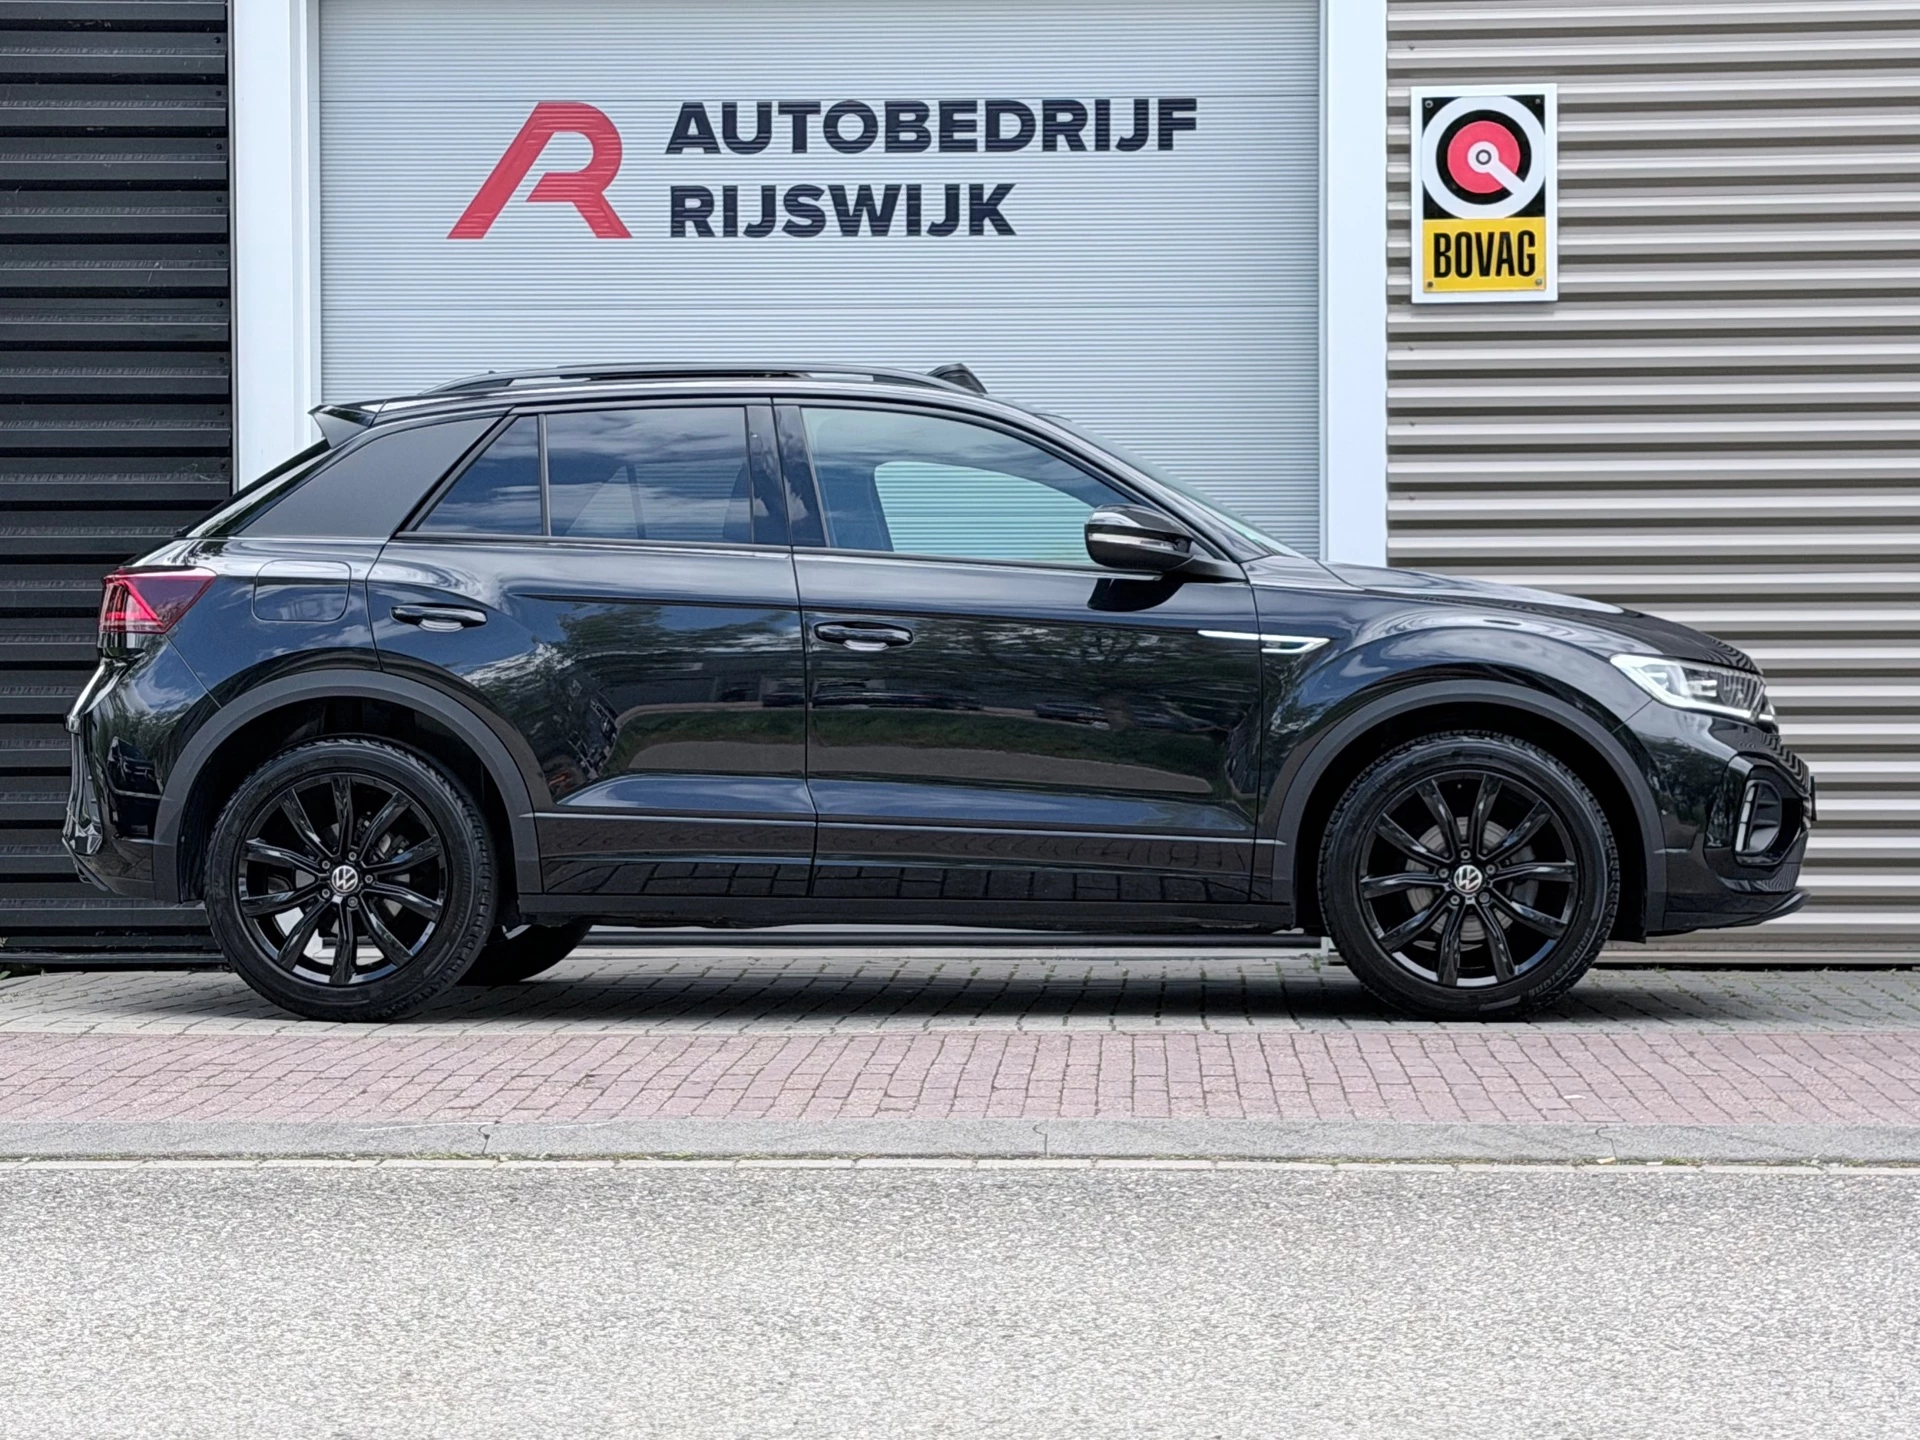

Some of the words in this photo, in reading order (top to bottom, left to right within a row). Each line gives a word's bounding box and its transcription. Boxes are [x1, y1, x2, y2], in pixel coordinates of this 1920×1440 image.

[665, 98, 1197, 153] AUTOBEDRIJF
[670, 184, 1016, 238] RIJSWIJK
[1433, 231, 1536, 278] BOVAG
